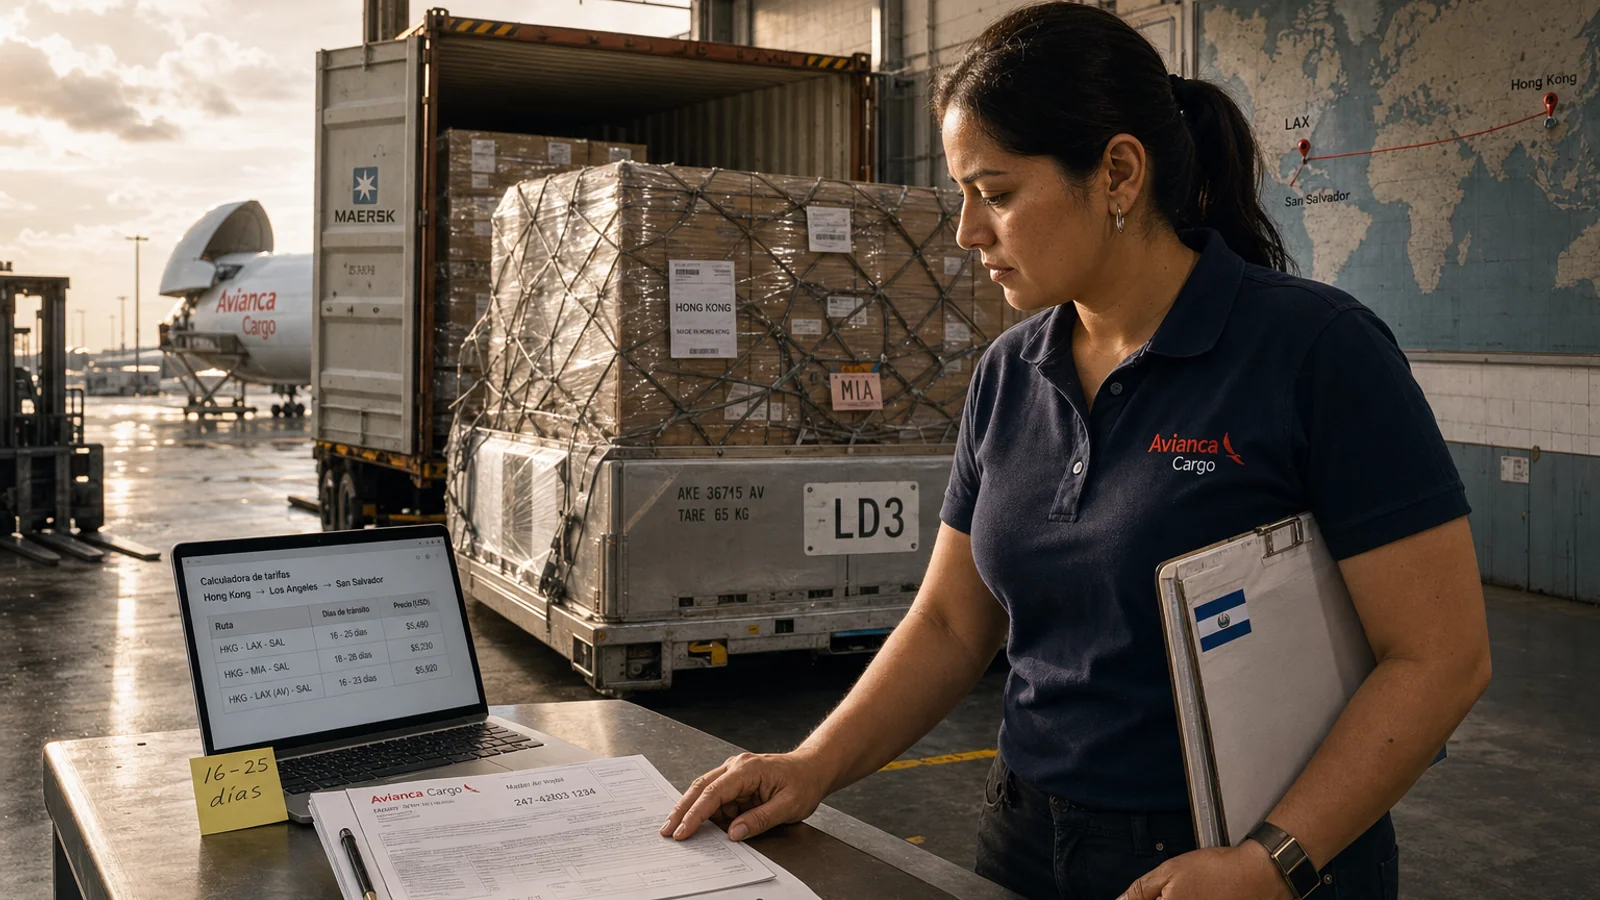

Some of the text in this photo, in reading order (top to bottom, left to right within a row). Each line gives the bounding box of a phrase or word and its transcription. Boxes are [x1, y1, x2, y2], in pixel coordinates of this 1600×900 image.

[1511, 74, 1577, 91] Hong Kong
[1285, 116, 1310, 130] LAX
[1285, 190, 1350, 207] San Salvador
[334, 210, 396, 222] MAERSK
[216, 288, 276, 312] Avianca
[676, 303, 732, 312] HONG KONG
[242, 316, 276, 340] Cargo
[841, 380, 874, 400] MIA
[1148, 433, 1218, 454] Avianca
[1172, 456, 1216, 475] Cargo
[678, 486, 700, 500] AKE
[750, 486, 764, 499] AV
[678, 508, 749, 522] TARE 65 KG
[834, 497, 904, 539] LD3
[200, 570, 290, 586] Calculadora de tarifas
[204, 576, 383, 602] Hong Kong Los Angeles San Salvador
[215, 622, 234, 630] Ruta
[220, 644, 238, 654] HKG
[246, 641, 262, 650] LAX
[269, 638, 285, 648] SAL
[224, 668, 243, 679] HKG
[250, 665, 267, 675] MIA
[273, 662, 290, 672] SAL
[228, 694, 248, 704] HKG
[255, 690, 272, 700] LAX
[273, 686, 289, 698] (AV)
[296, 684, 312, 693] SAL
[371, 786, 462, 804] Avianca Cargo
